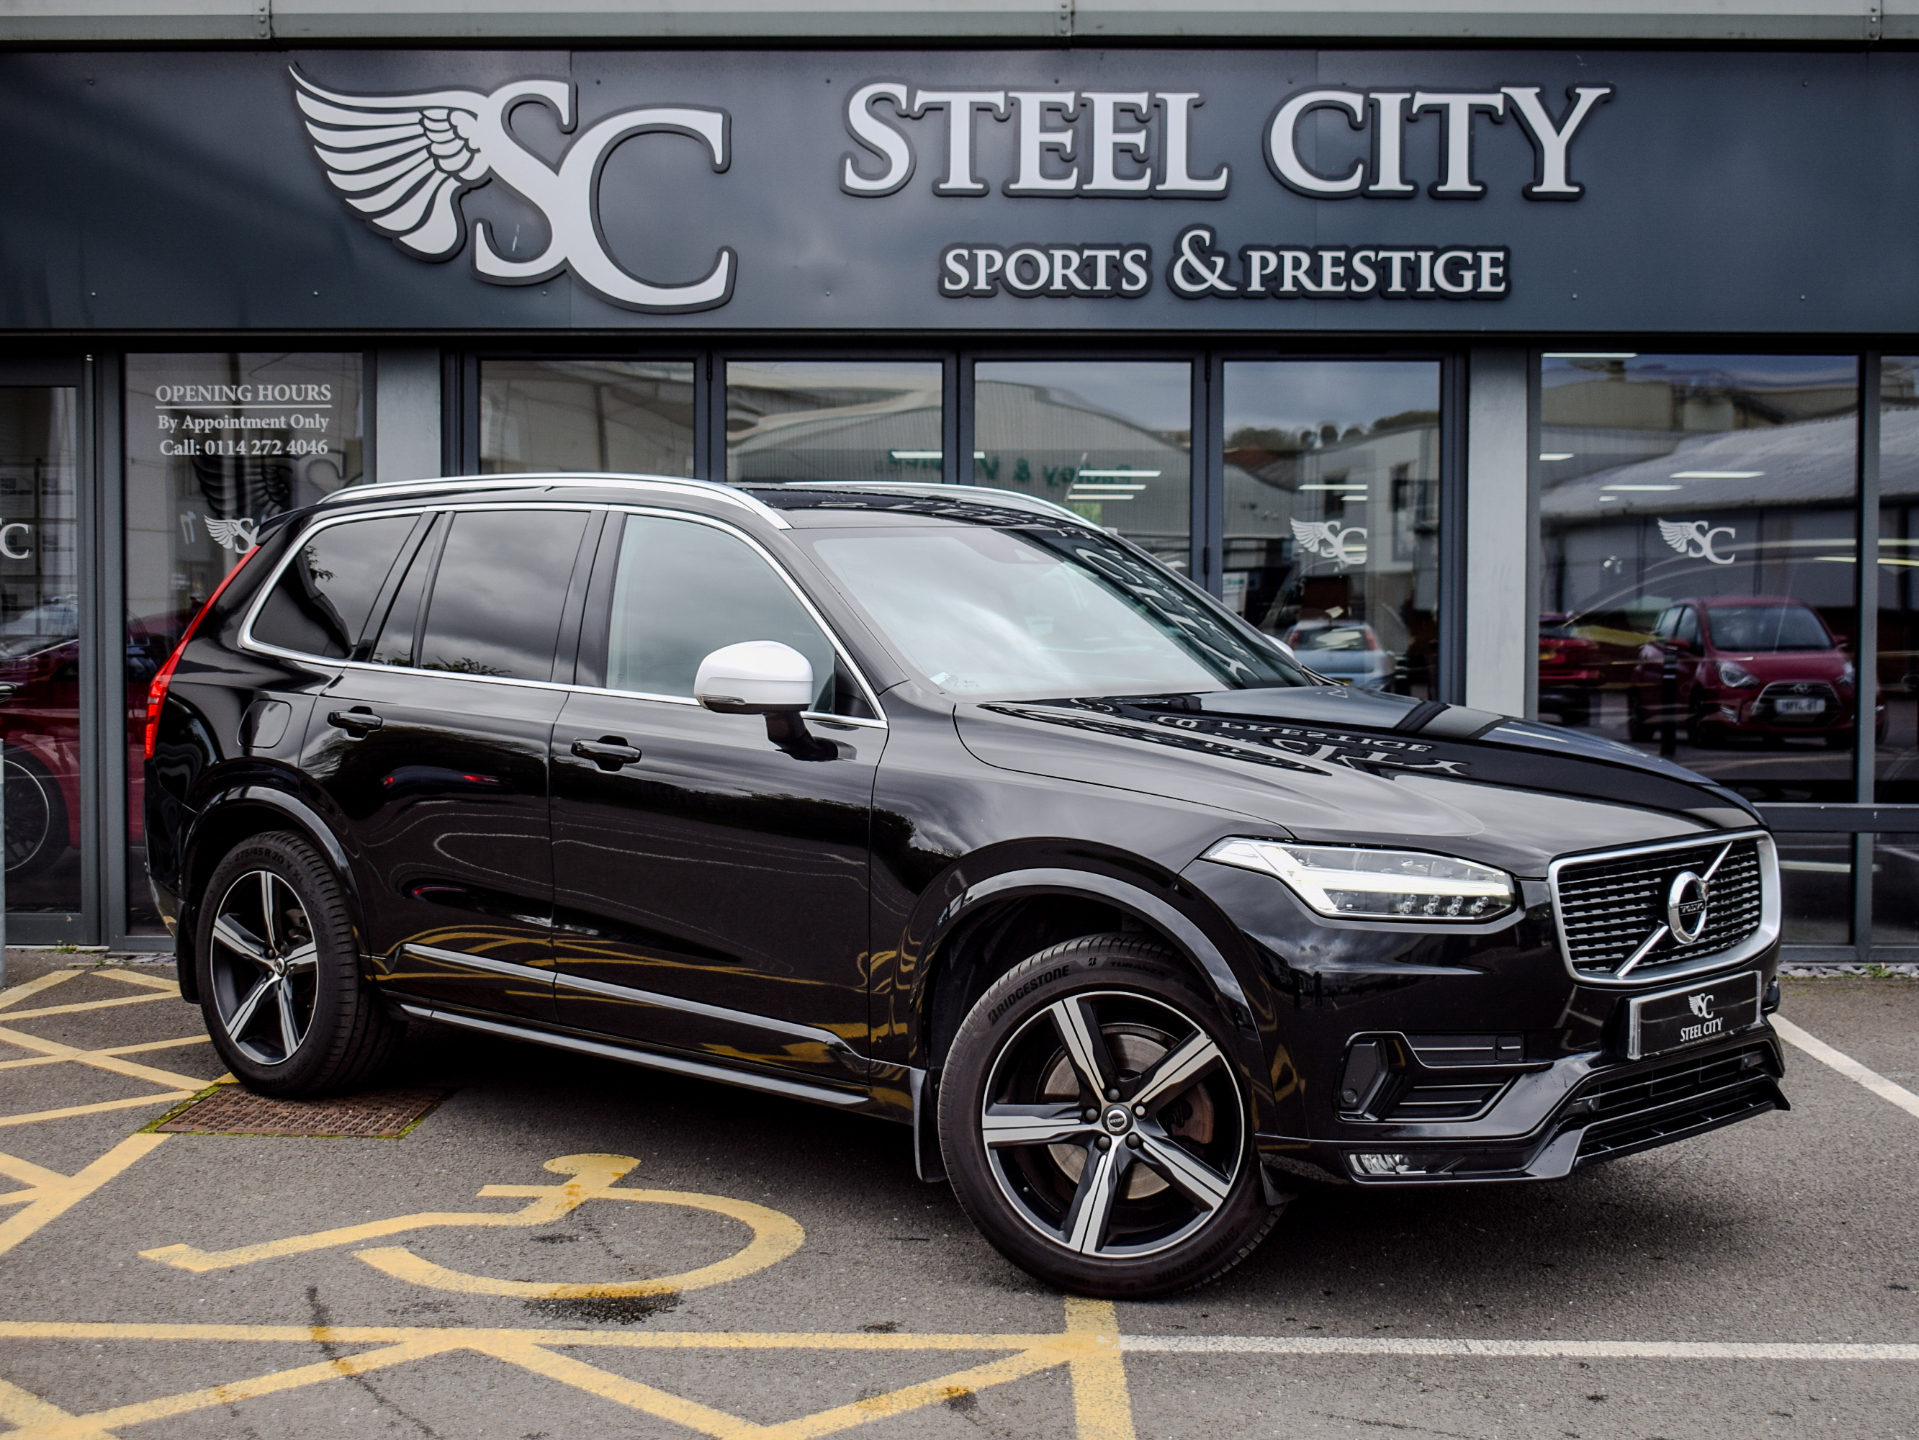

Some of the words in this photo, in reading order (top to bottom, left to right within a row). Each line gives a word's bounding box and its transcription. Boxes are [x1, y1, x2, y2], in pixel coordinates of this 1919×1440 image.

[843, 82, 1229, 194] STEEL
[1268, 85, 1612, 195] CITY
[474, 78, 733, 307] SC
[942, 246, 1149, 293] SPORTS
[1171, 229, 1237, 294] &
[1246, 249, 1507, 294] PRESTIGE
[155, 384, 253, 402] OPENING
[257, 383, 332, 401] HOURS
[157, 415, 179, 434] By
[181, 415, 287, 434] Appointment
[289, 413, 330, 433] Only
[159, 438, 201, 456] Call:
[204, 439, 247, 456] 0114
[250, 439, 282, 455] 272
[286, 438, 329, 455] 4046
[0, 517, 30, 560] C
[1319, 520, 1368, 565] SC
[1687, 520, 1737, 565] SC
[987, 964, 1070, 1027] BRIDGESTONE
[1680, 1023, 1702, 1042] STEEL
[1703, 1017, 1724, 1035] CITY
